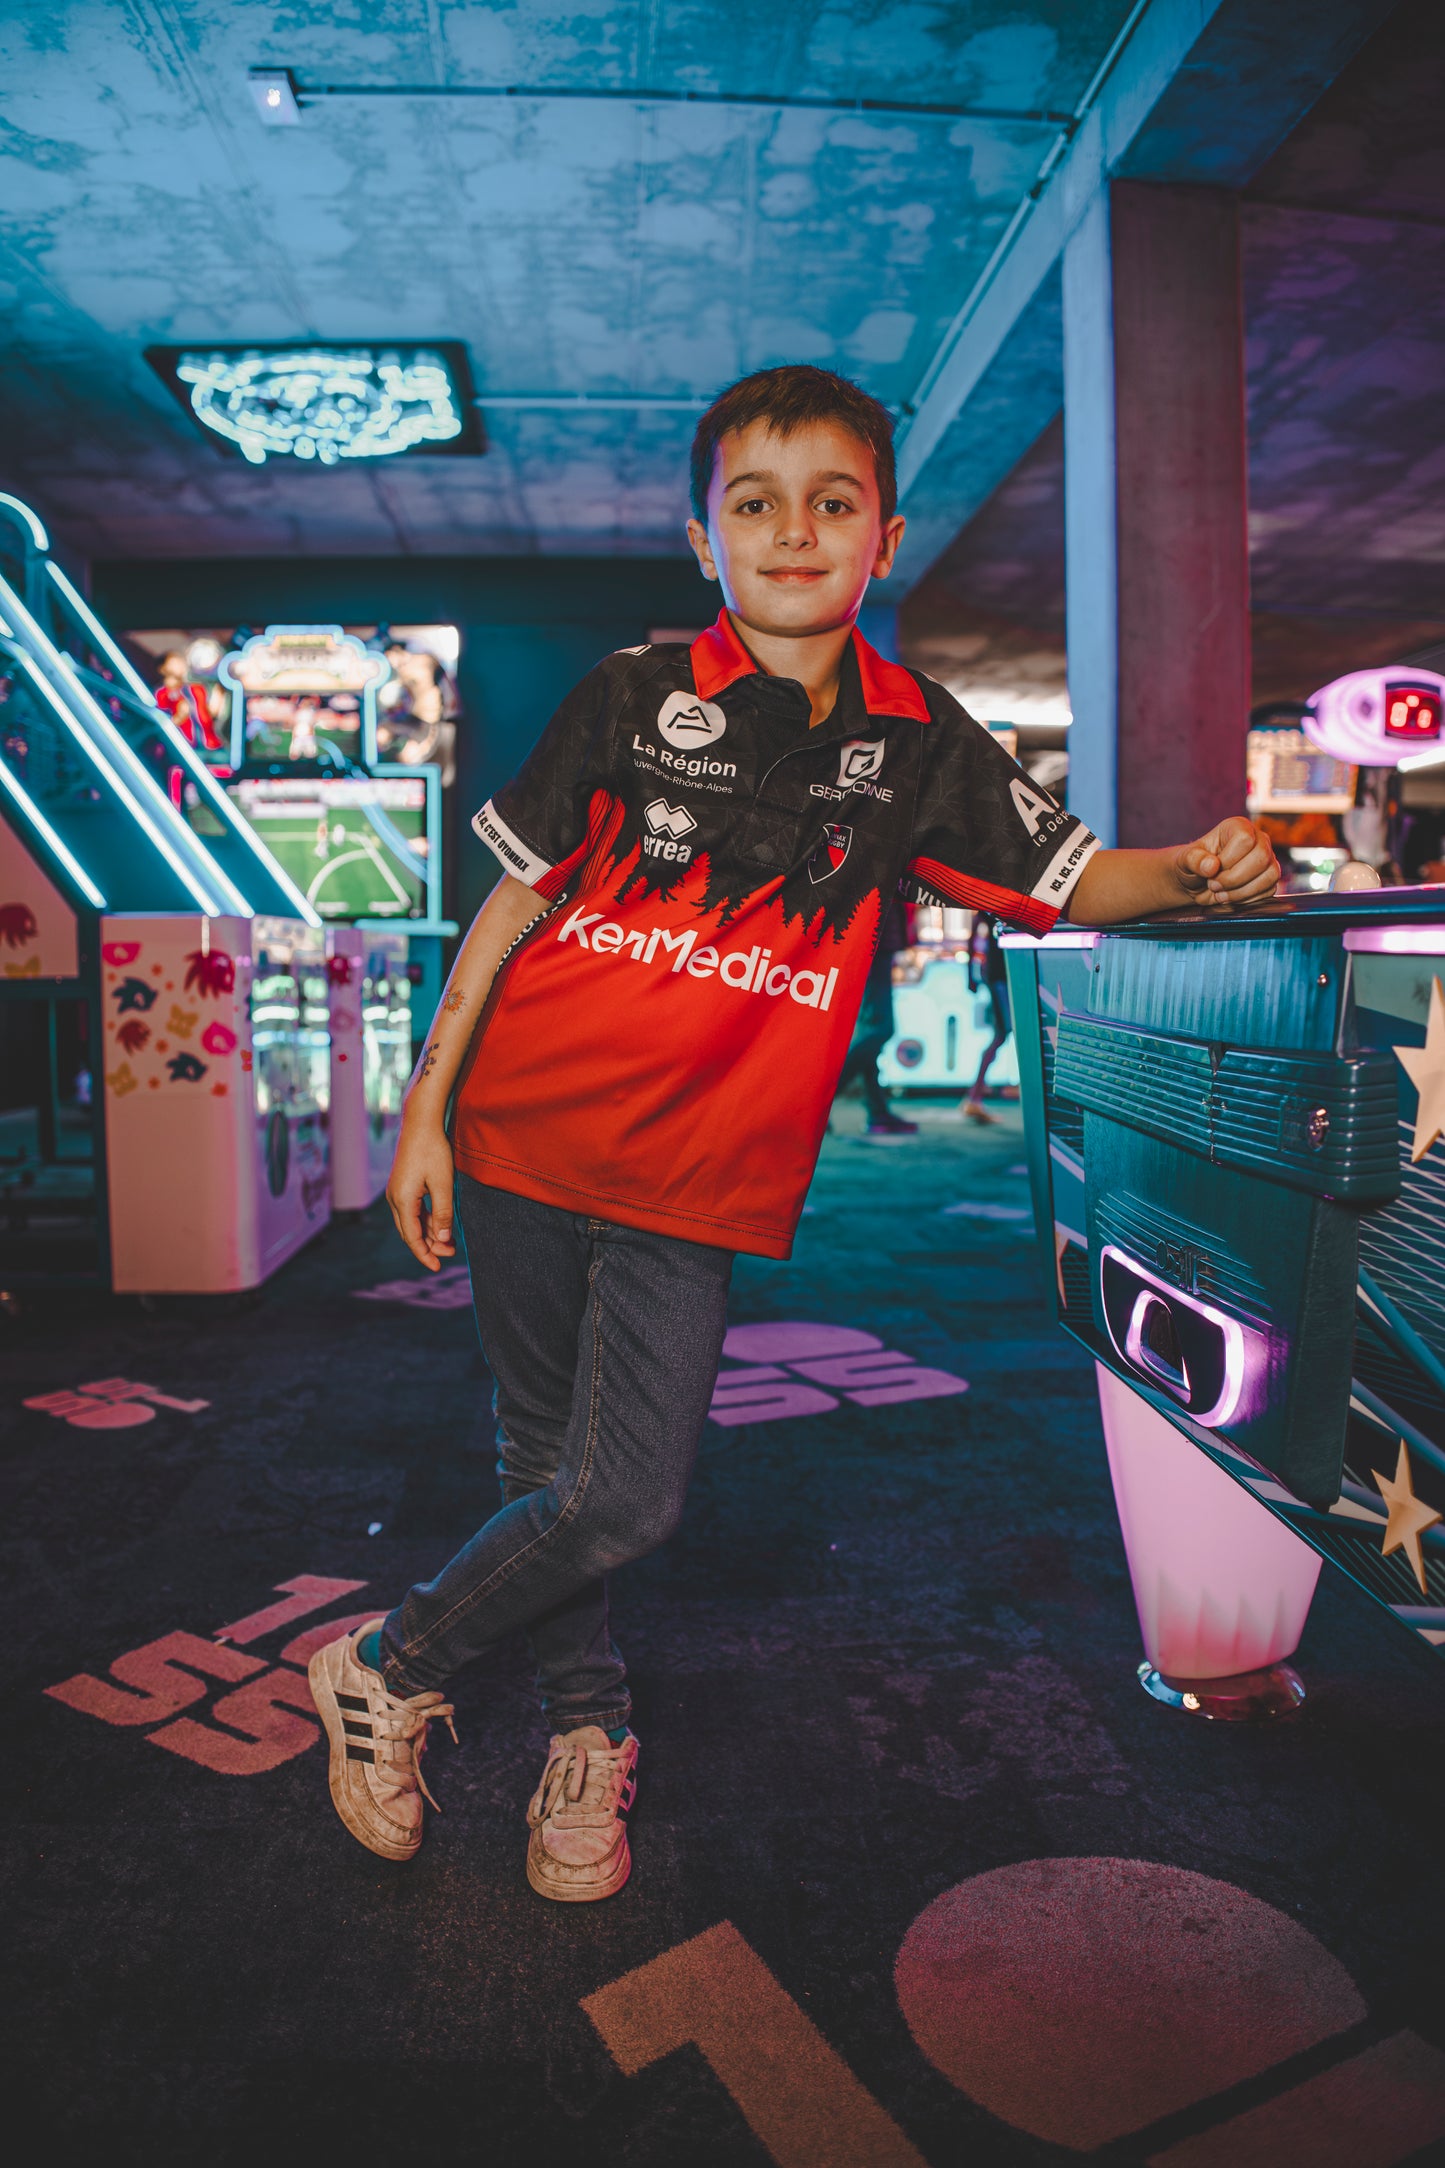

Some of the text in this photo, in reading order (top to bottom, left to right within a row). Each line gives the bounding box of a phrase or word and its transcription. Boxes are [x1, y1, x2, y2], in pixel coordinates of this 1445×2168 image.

[633, 734, 737, 777] La Région
[497, 839, 530, 873] OYONNAX
